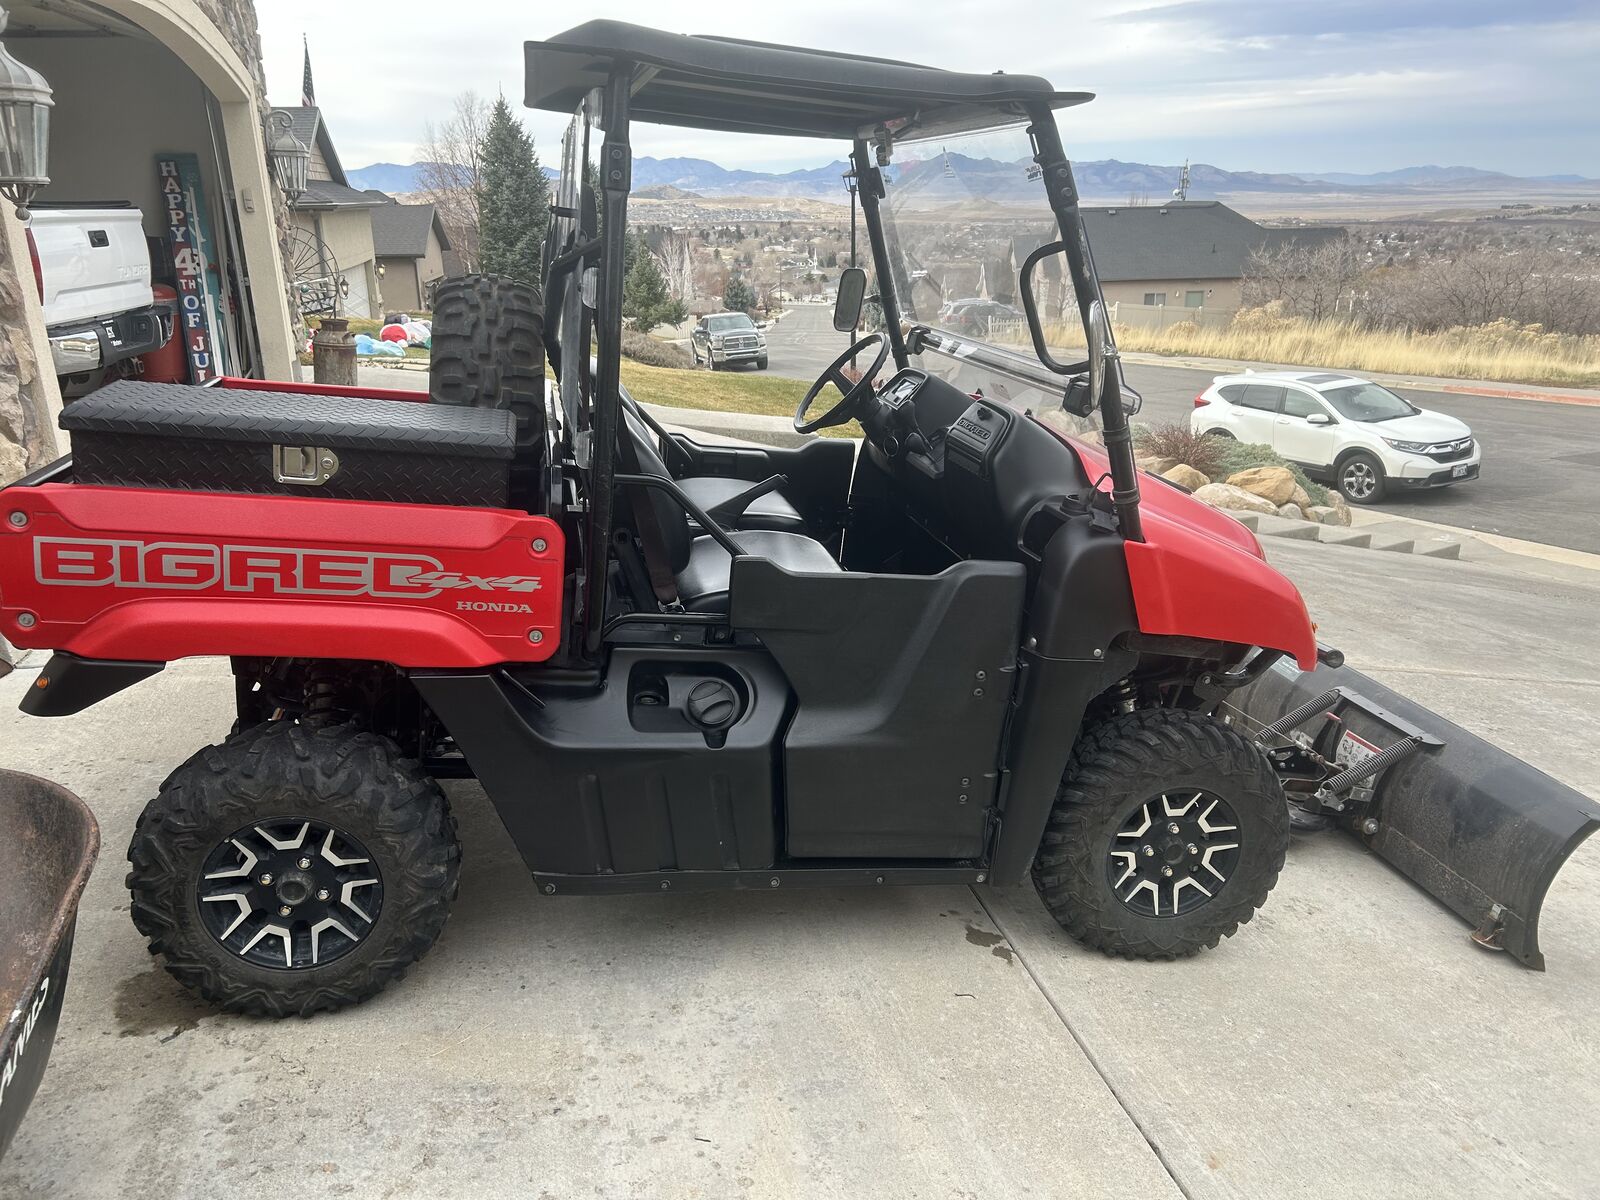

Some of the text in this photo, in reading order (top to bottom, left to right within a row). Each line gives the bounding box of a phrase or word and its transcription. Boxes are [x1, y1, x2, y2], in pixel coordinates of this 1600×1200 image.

[160, 161, 187, 242] HAPPY
[183, 295, 200, 328] OF
[456, 600, 534, 614] HONDA
